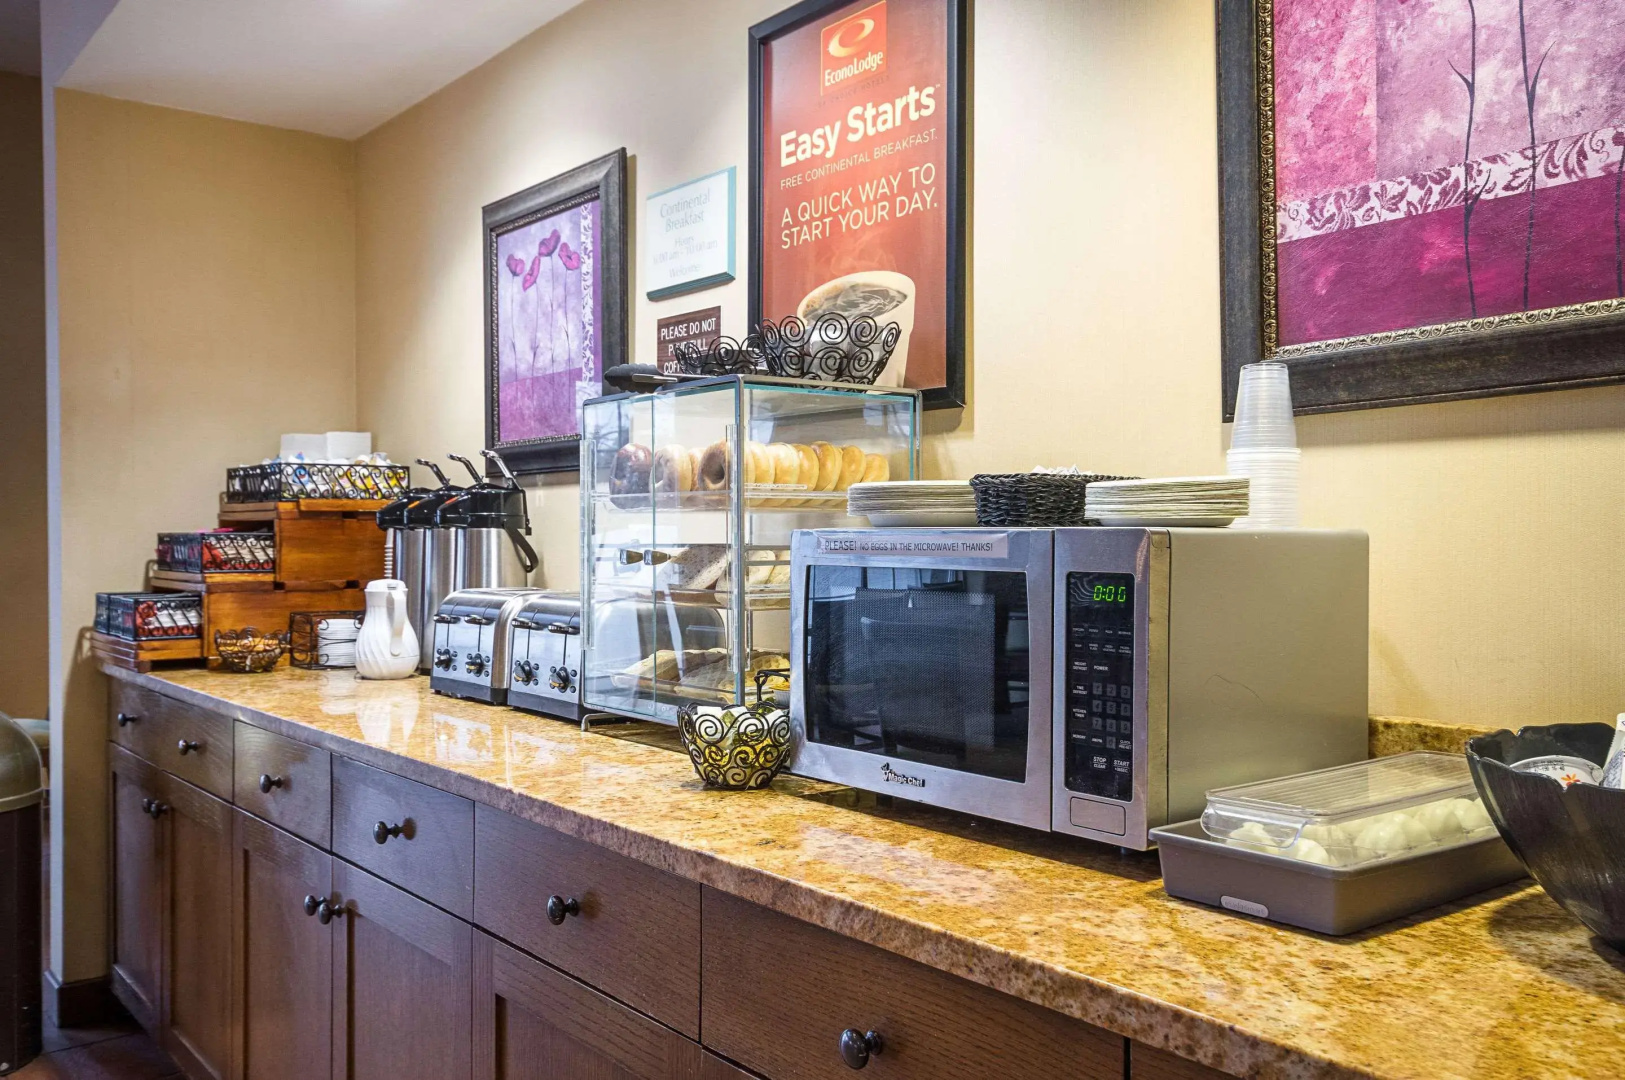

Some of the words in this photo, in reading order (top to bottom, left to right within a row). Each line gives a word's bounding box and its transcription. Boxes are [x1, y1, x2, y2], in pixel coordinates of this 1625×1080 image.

[824, 52, 883, 86] EconoLodge
[781, 120, 841, 168] Easy
[781, 174, 802, 190] FREE
[805, 152, 870, 182] CONTINENTAL
[874, 128, 938, 159] BREAKFAST.
[660, 187, 710, 218] Continental
[781, 208, 793, 227] A
[798, 188, 853, 222] QUICK
[859, 172, 902, 203] WAY
[908, 163, 935, 188] TO
[665, 210, 704, 232] Breakfast
[781, 217, 833, 249] START
[838, 201, 889, 232] YOUR
[896, 187, 938, 217] DAY.
[661, 324, 687, 340] PLEASE
[690, 322, 699, 335] DO
[702, 318, 716, 332] NOT
[825, 540, 857, 551] PLEASE!
[914, 543, 958, 551] MICROWAVE!
[961, 543, 993, 551] THANKS!
